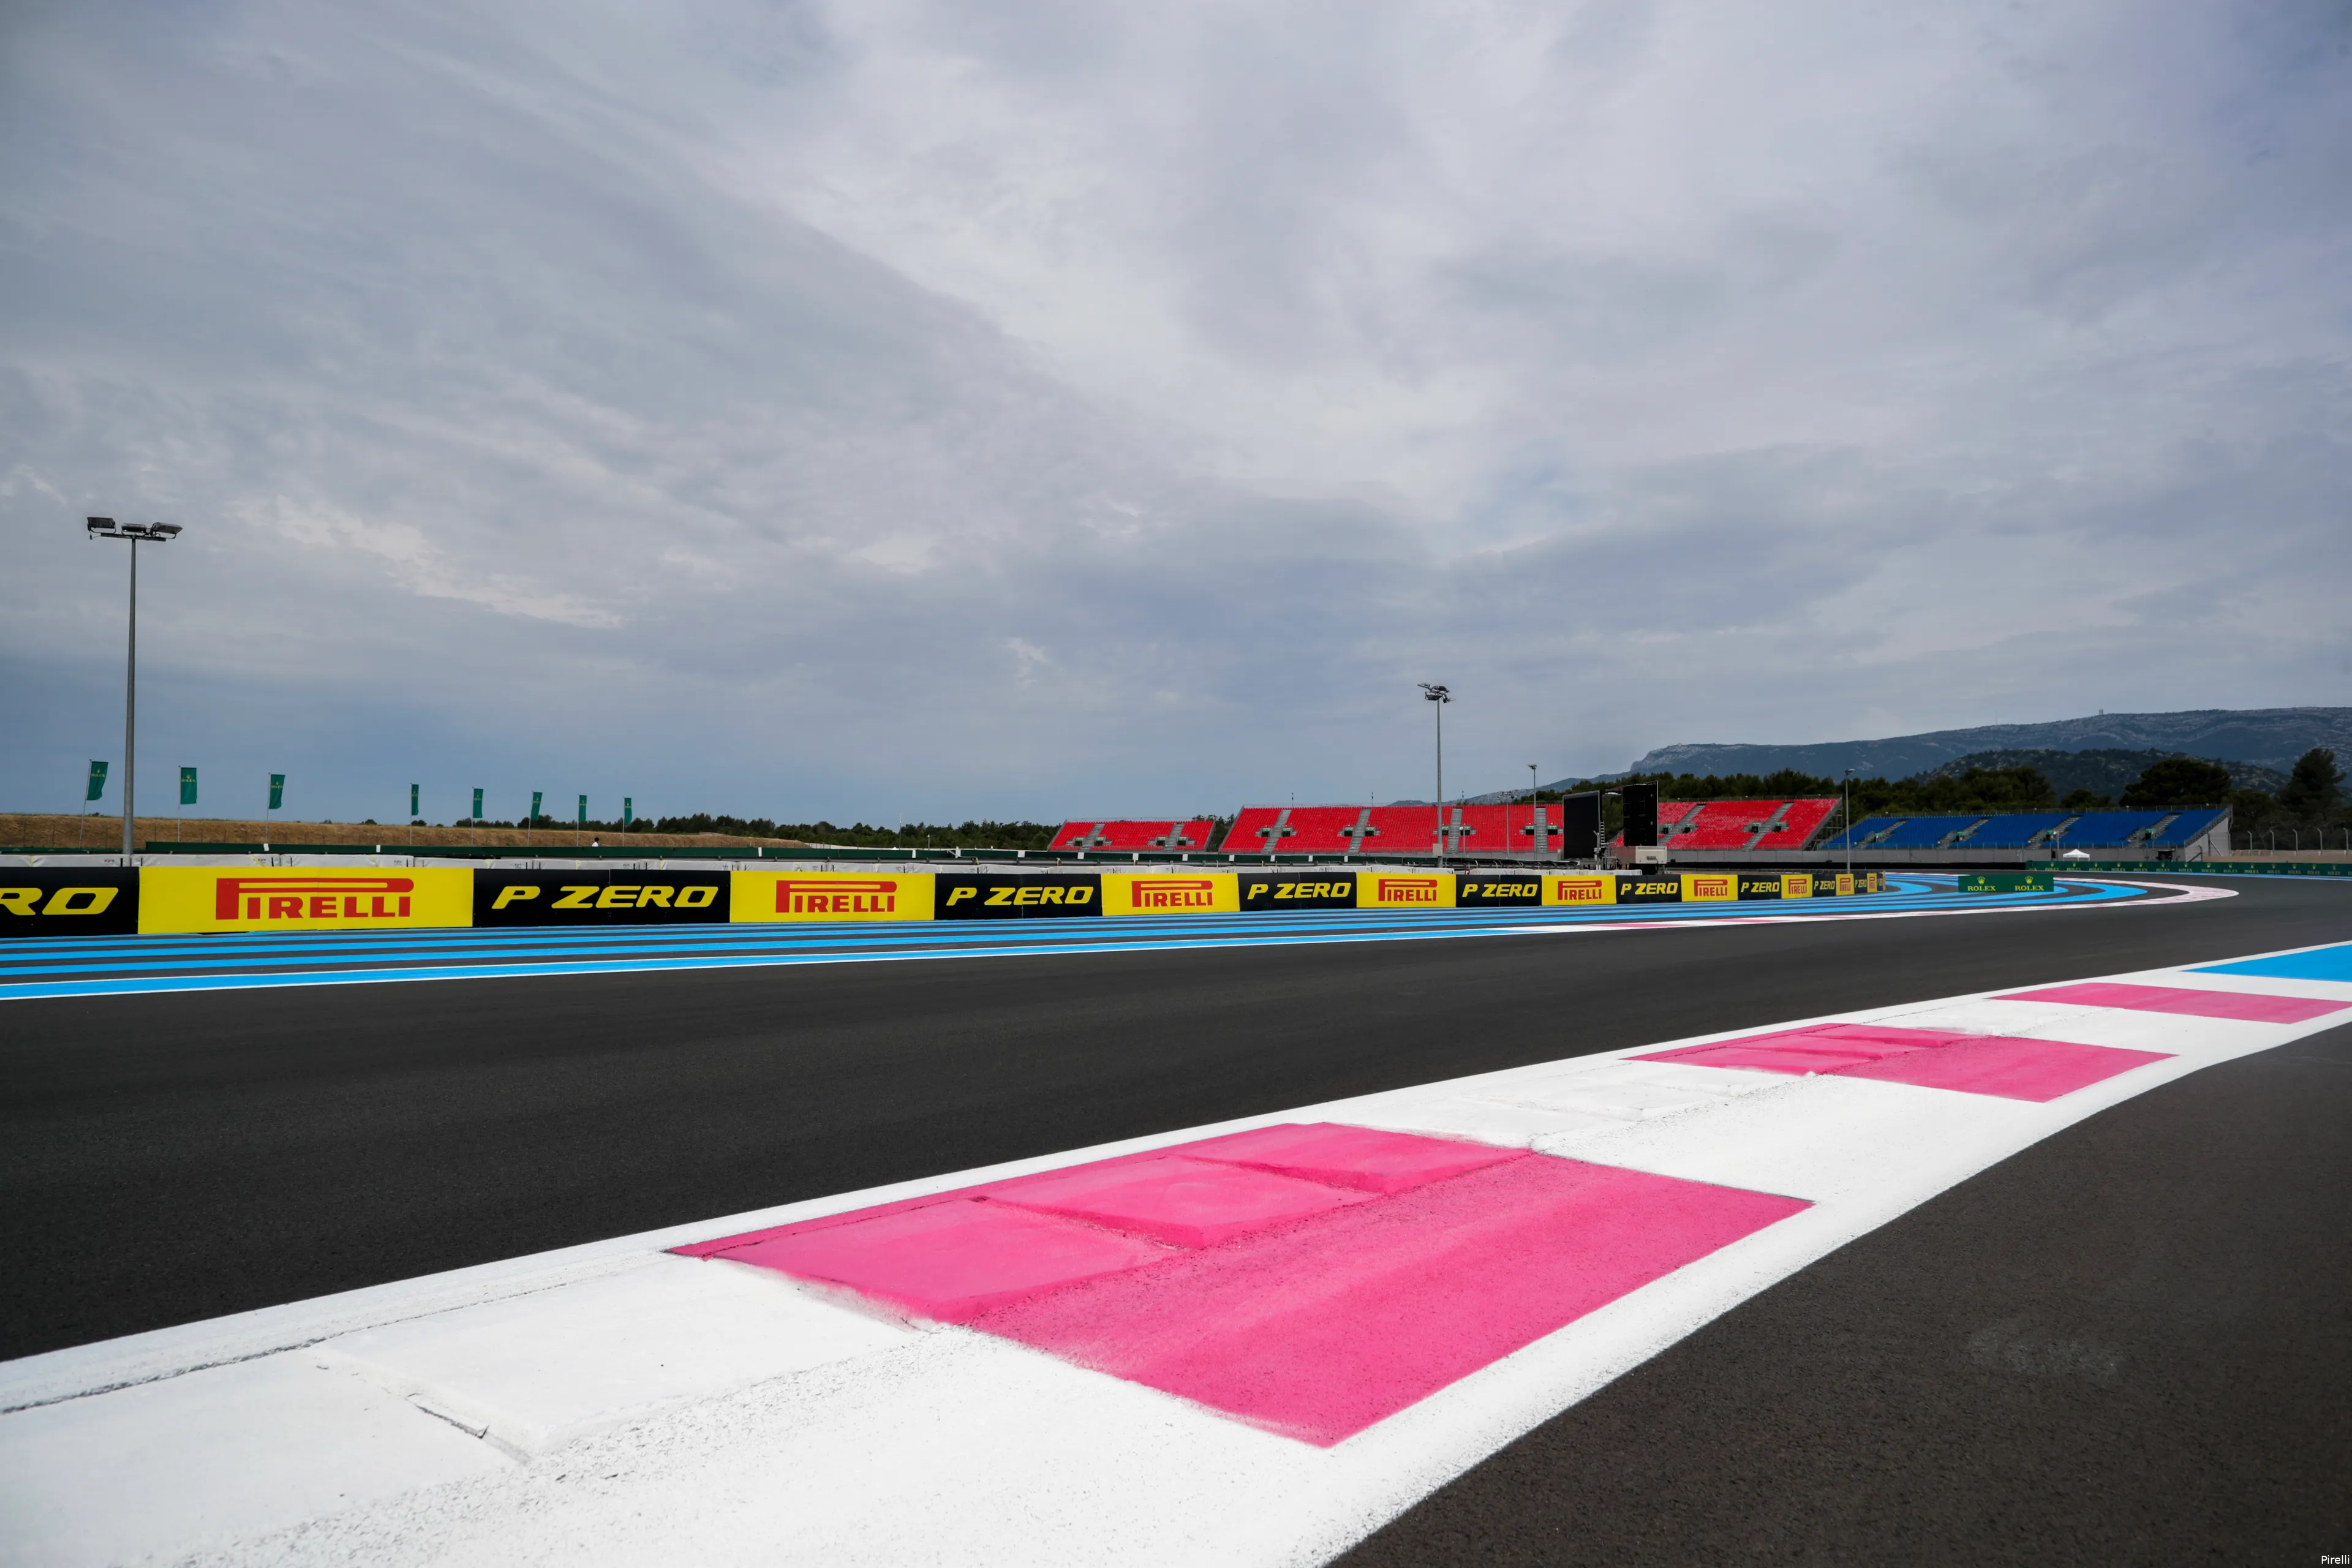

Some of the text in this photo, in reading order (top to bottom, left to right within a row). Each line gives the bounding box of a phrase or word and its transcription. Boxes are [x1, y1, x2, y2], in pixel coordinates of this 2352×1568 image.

[1131, 880, 1213, 908] PIRELLI
[1247, 882, 1352, 900] P ZERO
[1378, 879, 1438, 902] PIRELLI
[1462, 884, 1539, 897] P ZERO
[1558, 880, 1602, 900] PIRELLI
[1621, 883, 1678, 895] P ZERO
[1694, 879, 1728, 897] PIRELLI
[1741, 882, 1779, 892] P ZERO
[1788, 878, 1807, 894] PIRELLI
[1814, 880, 1835, 890] P ZERO
[216, 878, 414, 920] PIRELLI
[492, 886, 718, 909] P ZERO
[775, 880, 897, 913] PIRELLI
[946, 886, 1094, 907] P ZERO
